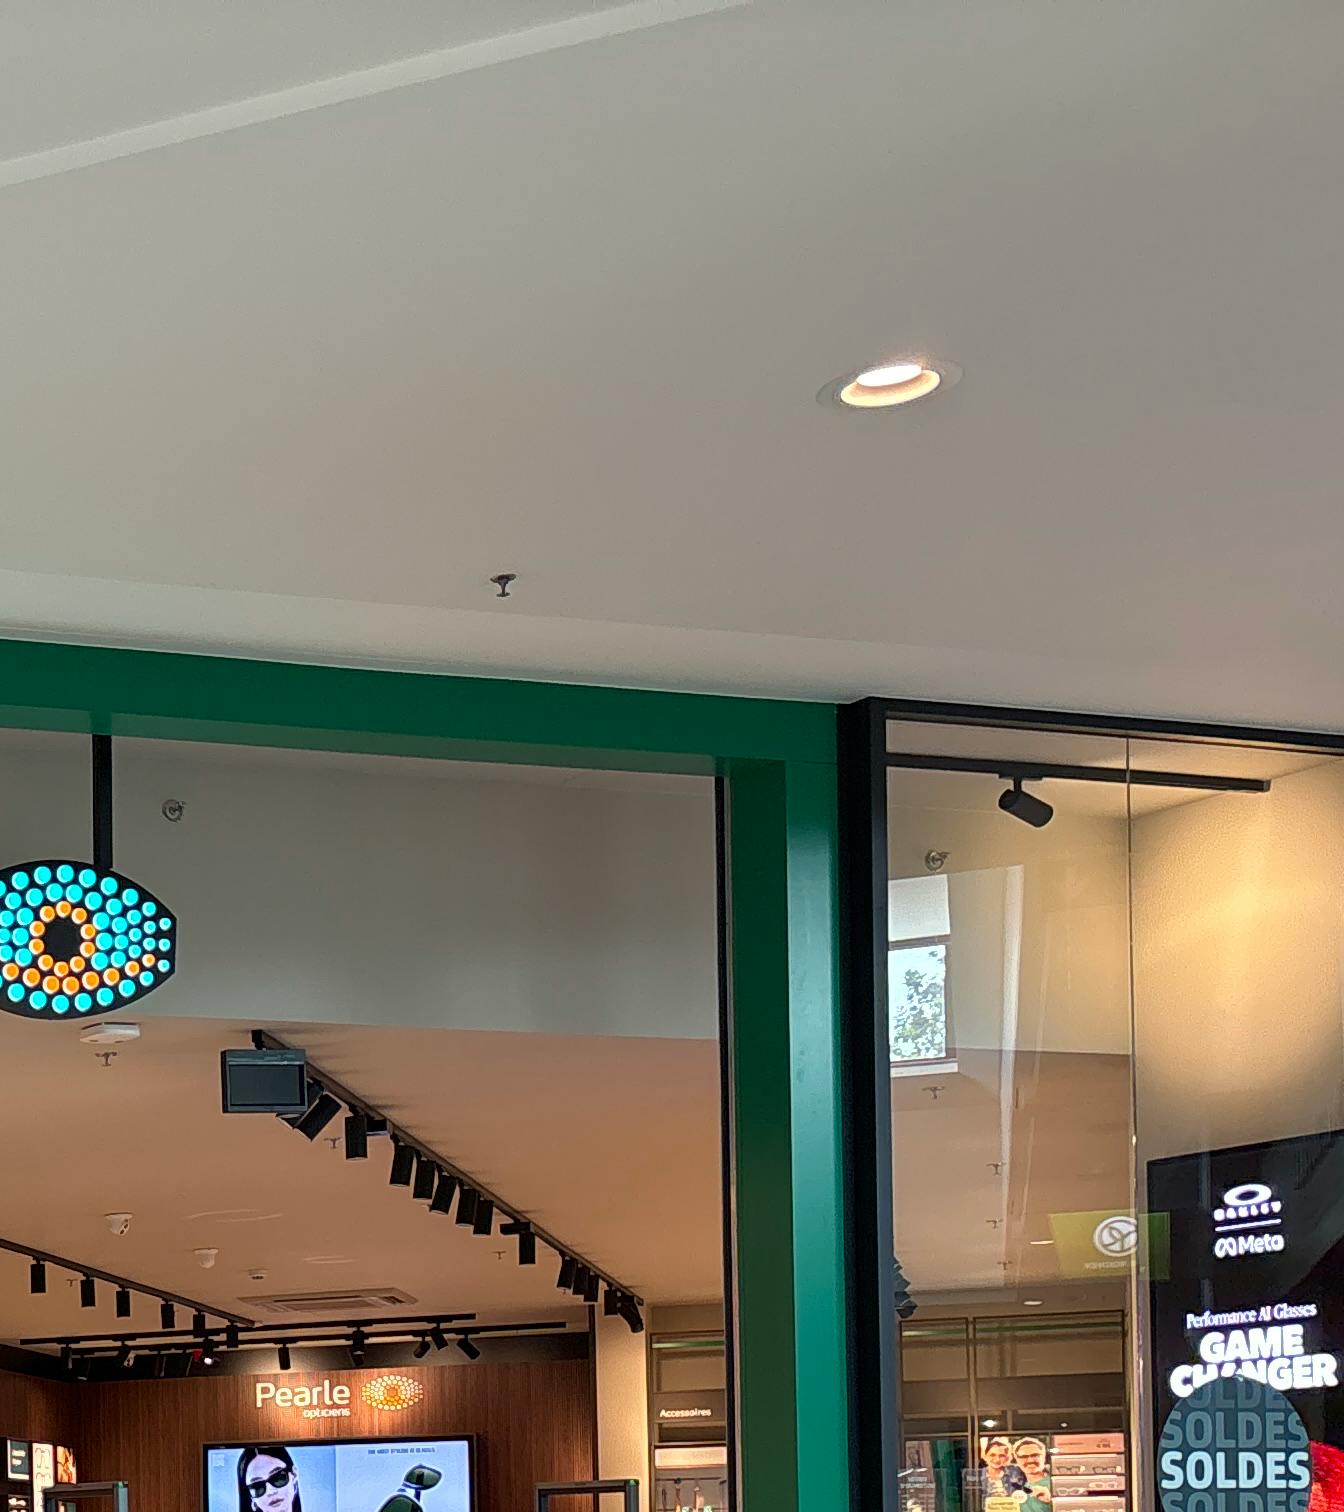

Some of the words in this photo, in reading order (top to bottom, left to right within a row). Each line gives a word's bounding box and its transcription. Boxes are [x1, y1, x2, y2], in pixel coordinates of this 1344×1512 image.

[1238, 1234, 1285, 1254] Meta
[1186, 1310, 1257, 1329] Performance
[1258, 1306, 1272, 1321] AI
[1273, 1303, 1318, 1318] Glasses
[1199, 1323, 1305, 1363] GAME
[255, 1380, 351, 1408] Pearle
[659, 1406, 712, 1418] Accessoires
[1162, 1411, 1308, 1449] SOLDES
[1160, 1451, 1311, 1490] SOLDES
